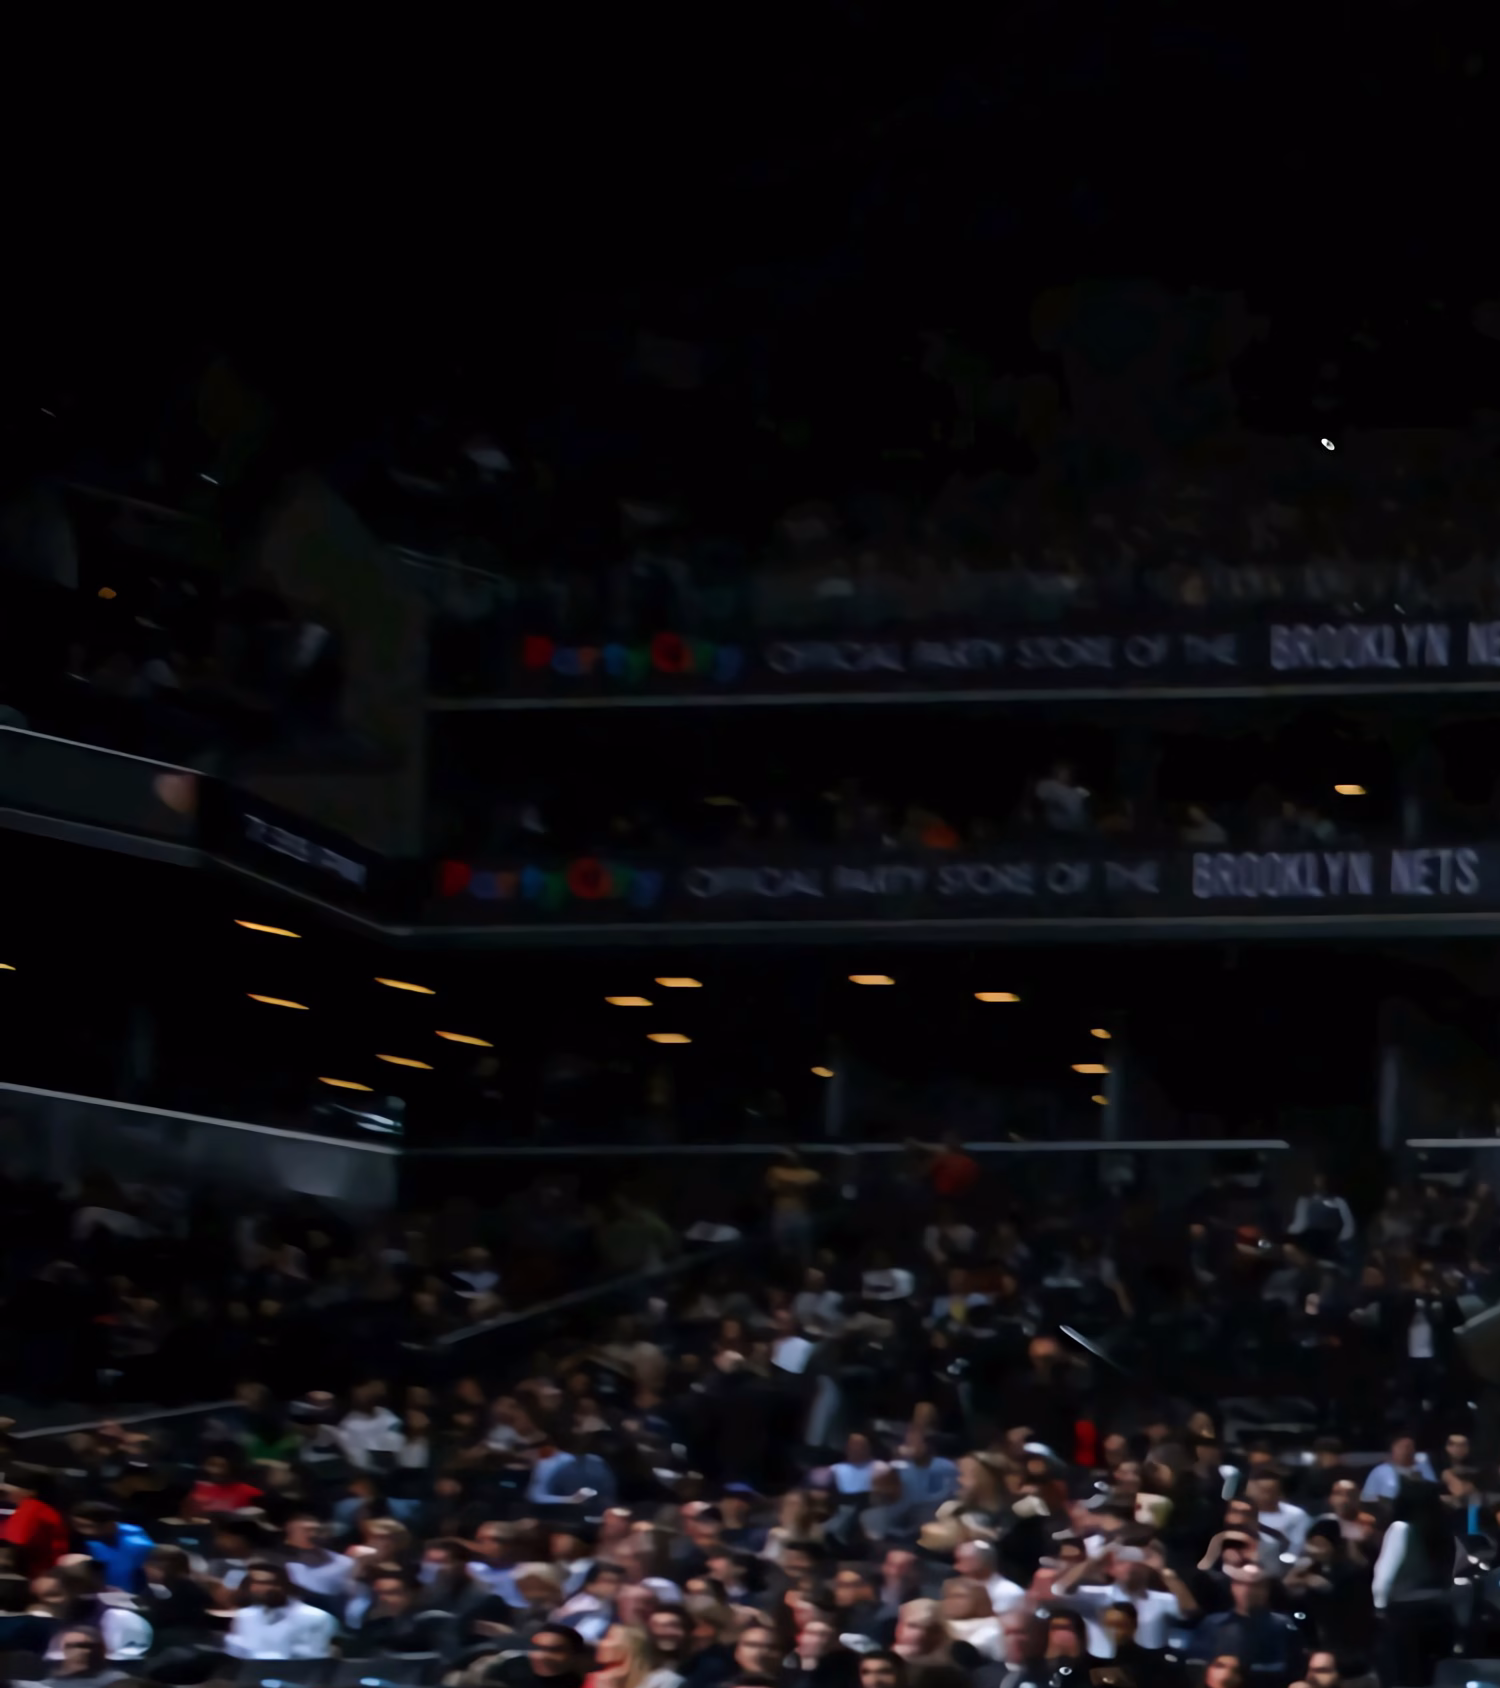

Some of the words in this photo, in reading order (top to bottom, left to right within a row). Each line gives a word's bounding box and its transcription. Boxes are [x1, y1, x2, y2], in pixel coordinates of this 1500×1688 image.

[1270, 623, 1451, 671] BROOKLYN
[1193, 852, 1373, 899] BROOKLYN
[1391, 847, 1479, 895] NETS
